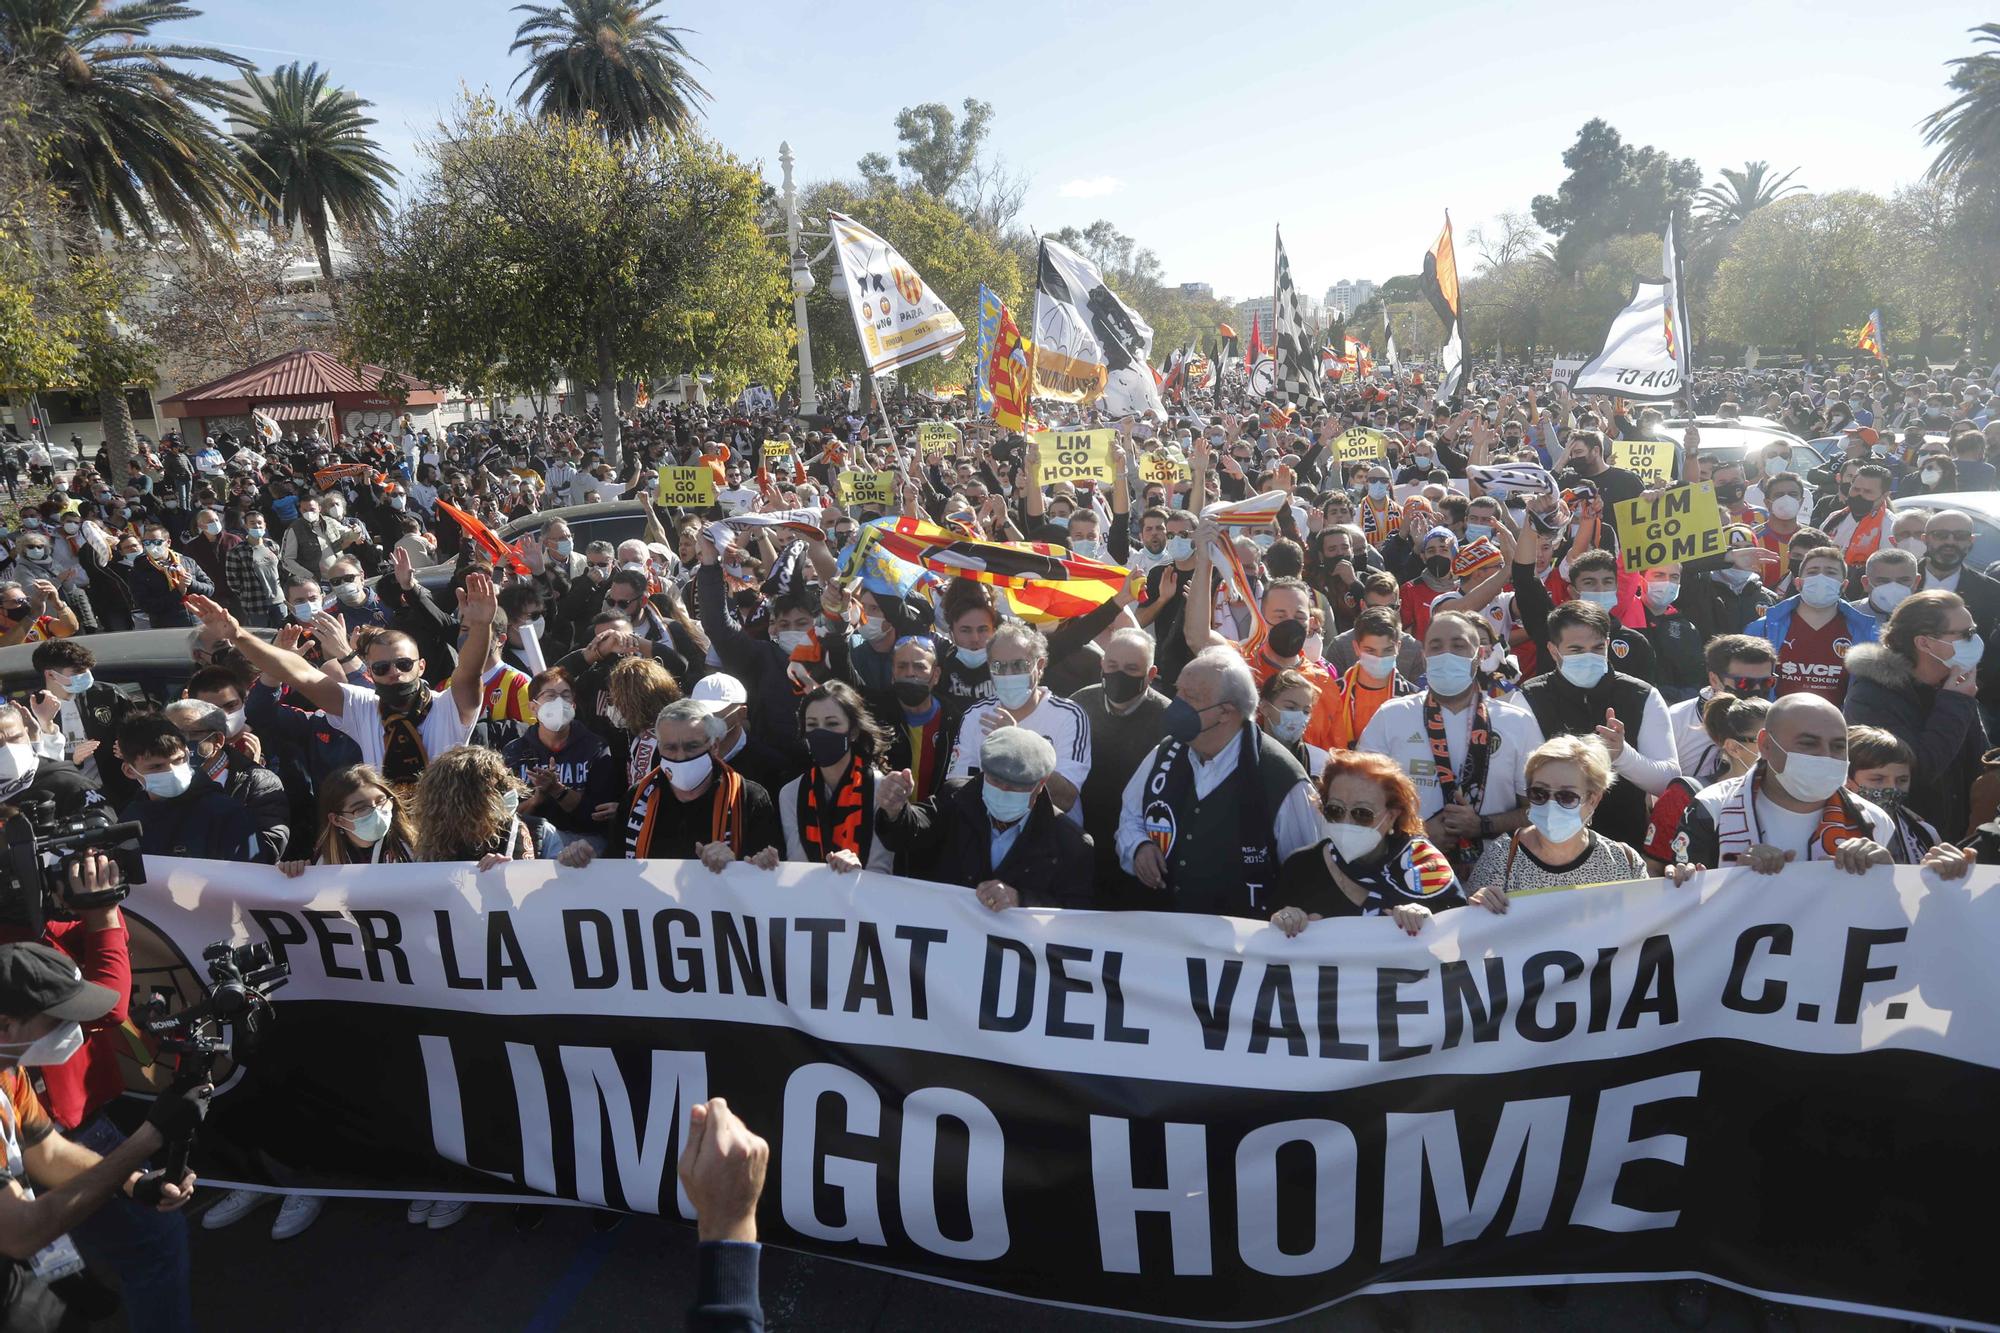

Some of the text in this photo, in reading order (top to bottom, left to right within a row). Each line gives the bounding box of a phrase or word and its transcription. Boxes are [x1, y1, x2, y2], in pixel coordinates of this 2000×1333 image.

[900, 307, 924, 322] PARA
[1554, 368, 1566, 378] GO
[1345, 427, 1368, 437] LIM
[1056, 435, 1091, 450] LIM
[1348, 436, 1367, 446] GO
[1339, 446, 1377, 459] HOME
[1629, 444, 1655, 456] LIM
[1058, 451, 1088, 465] GO
[1629, 456, 1653, 467] GO
[1154, 460, 1175, 470] GO
[672, 469, 696, 480] LIM
[853, 473, 878, 481] LIM
[1044, 466, 1104, 480] HOME
[1145, 469, 1185, 480] HOME
[1631, 468, 1662, 479] OME
[675, 481, 695, 491] GO
[854, 482, 875, 490] GO
[665, 493, 706, 503] HOME
[845, 490, 886, 502] HOME
[1630, 488, 1691, 526] LIM
[1646, 519, 1681, 540] GO
[1626, 528, 1719, 570] HOME
[1805, 676, 1840, 684] TOKEN
[576, 761, 589, 783] CF
[1243, 855, 1265, 863] 2015
[248, 908, 1909, 1061] PER LA DIGNITAT DEL VALENCIA C.F.
[418, 1035, 1701, 1276] LIM GO HOME
